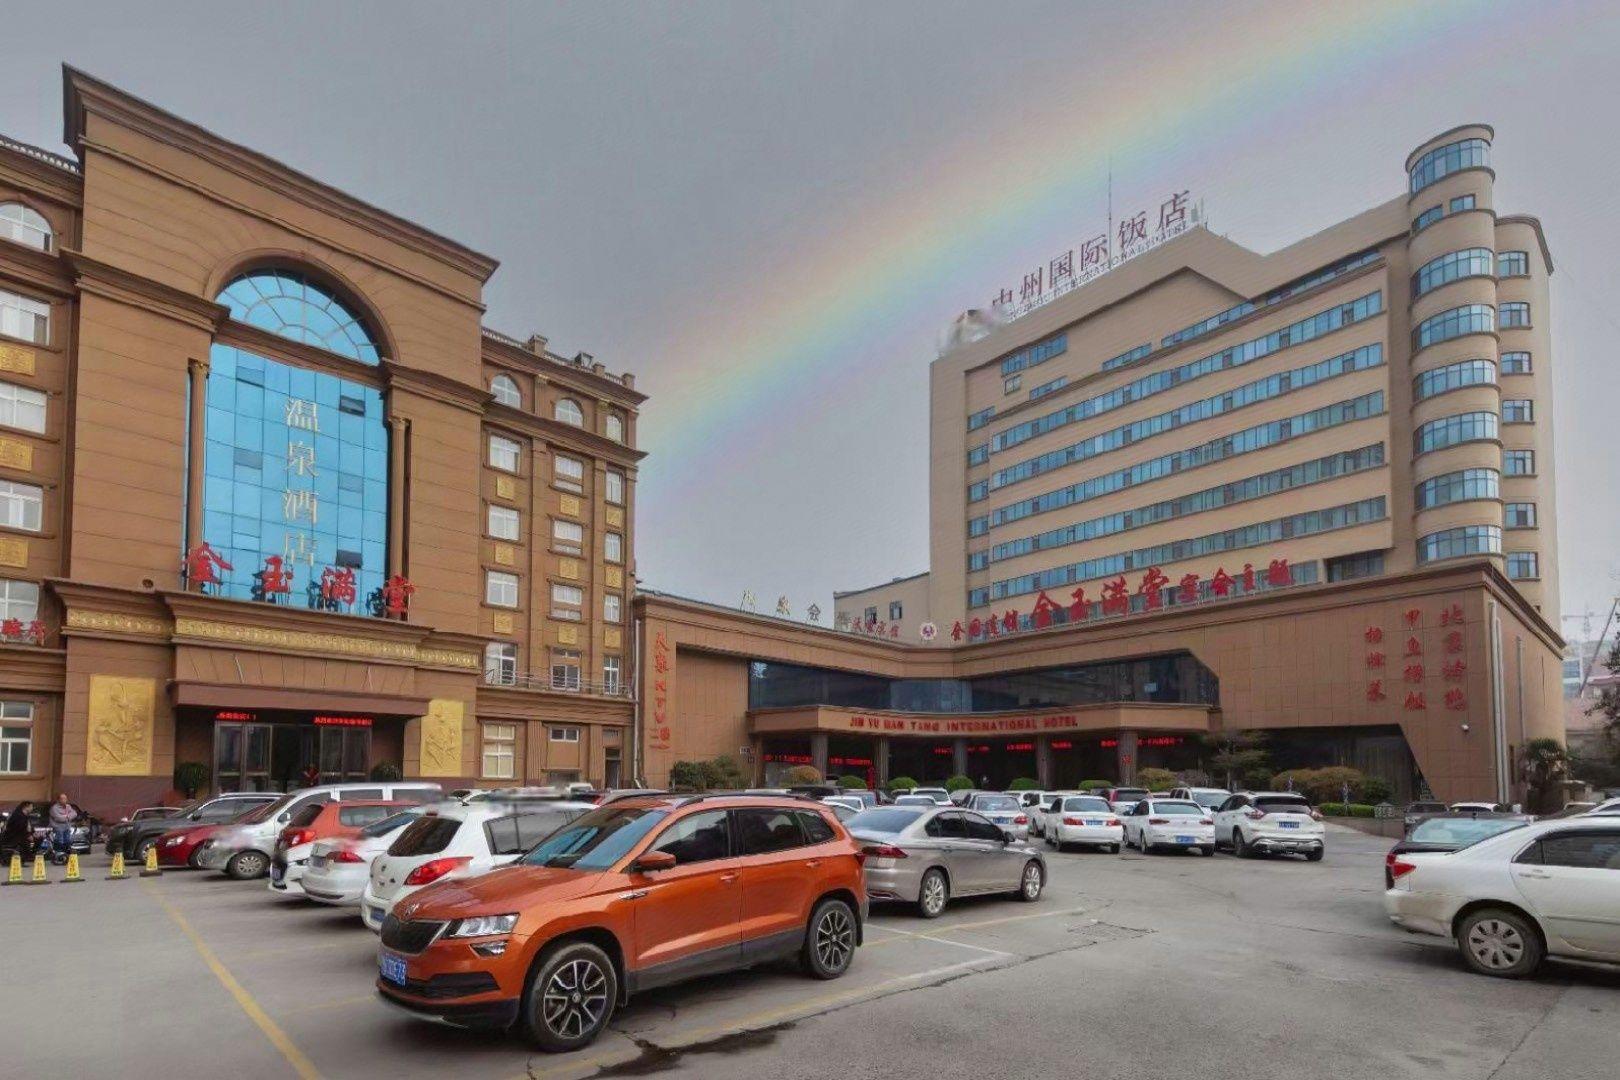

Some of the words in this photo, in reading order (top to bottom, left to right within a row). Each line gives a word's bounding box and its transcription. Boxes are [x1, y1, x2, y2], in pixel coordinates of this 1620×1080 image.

[284, 397, 320, 567] 温泉酒店
[946, 718, 1038, 732] INTERNATIONAL
[1043, 715, 1078, 728] HOTEL
